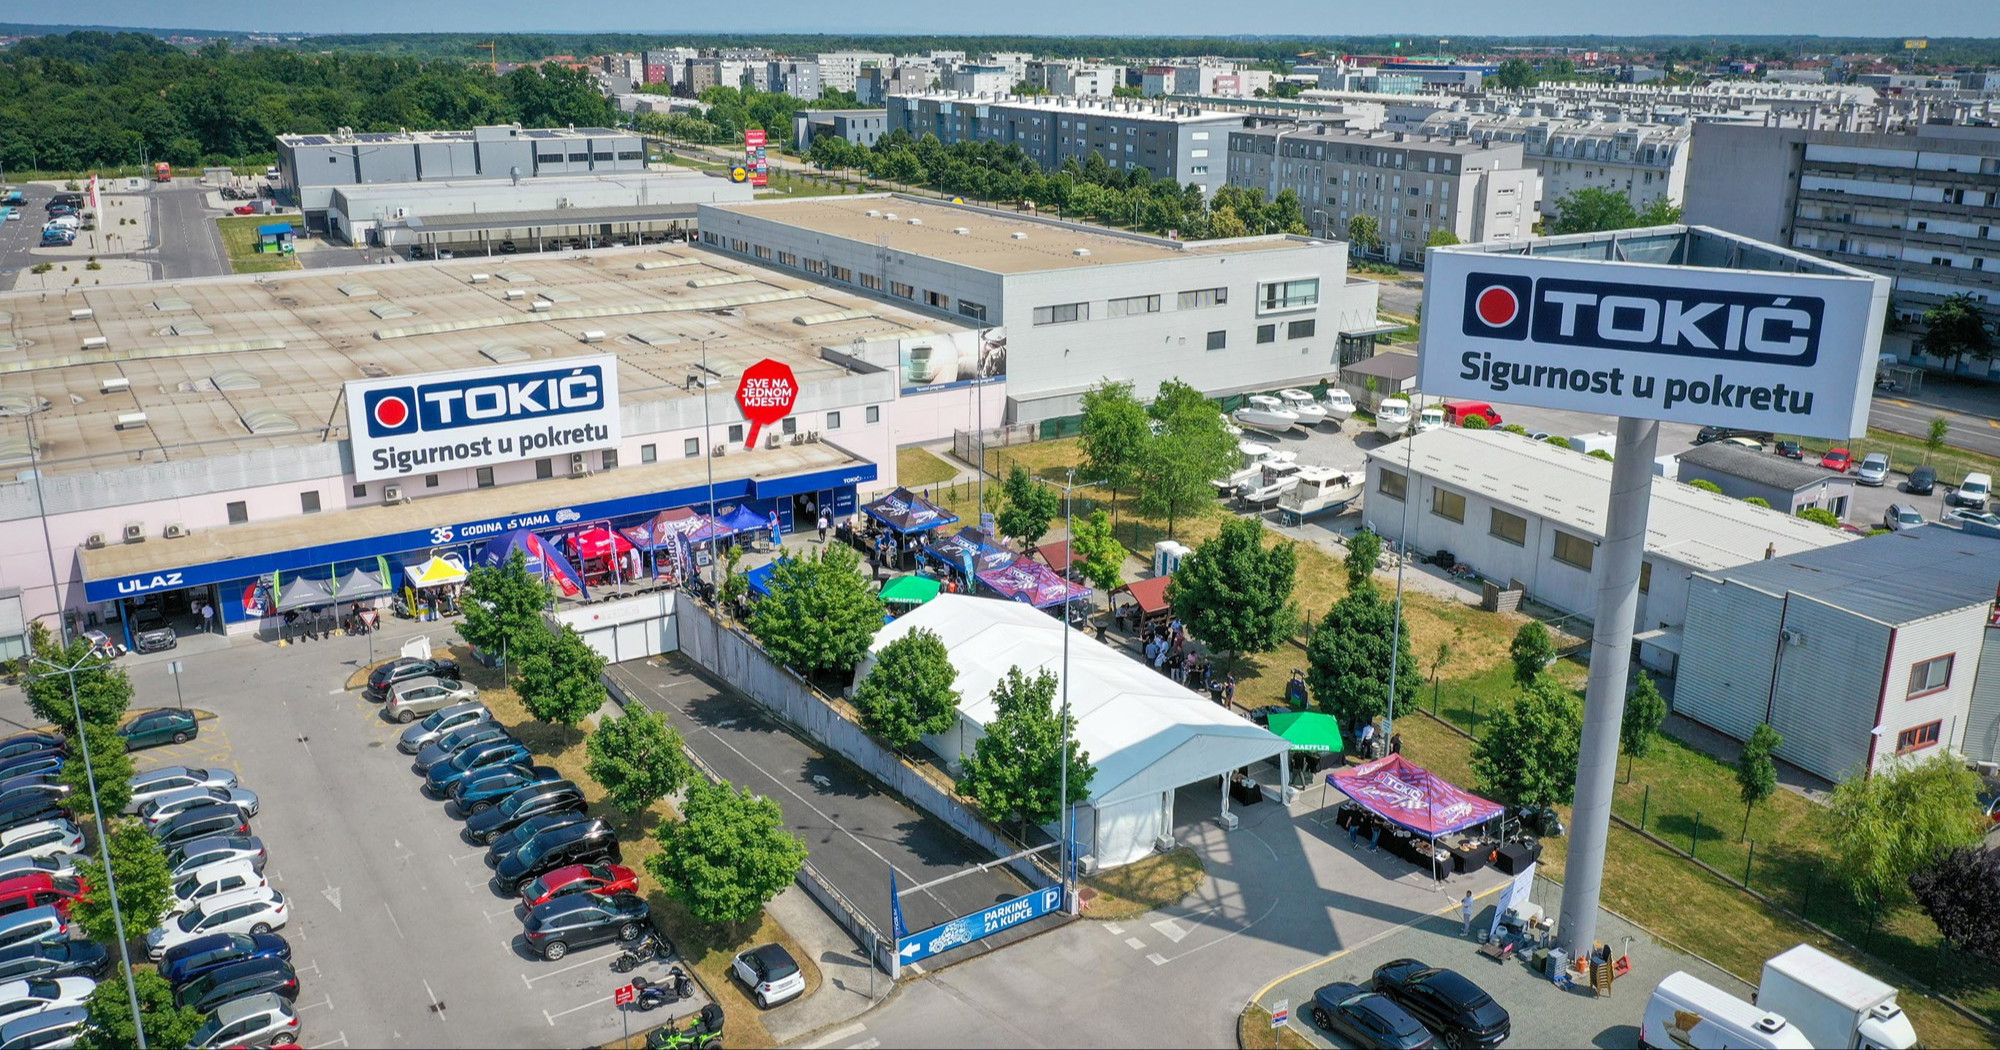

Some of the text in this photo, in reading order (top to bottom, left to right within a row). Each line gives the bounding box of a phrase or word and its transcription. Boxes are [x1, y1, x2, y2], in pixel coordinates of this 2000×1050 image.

[1544, 290, 1811, 356] TOKIĆ
[742, 388, 792, 398] JEDNOM
[746, 378, 789, 388] SVE NA
[1459, 350, 1814, 415] Sigurnost u pokretu
[424, 368, 599, 424] TOKIĆ
[744, 397, 789, 407] MJESTU
[372, 422, 609, 473] Sigurnost u pokretu
[430, 526, 455, 545] 35
[461, 521, 503, 537] GODINA
[519, 514, 550, 527] VAMA
[117, 572, 184, 594] ULAZ
[984, 898, 1029, 923] PARKING
[1045, 890, 1058, 909] P
[984, 906, 1033, 933] ZA KUPCE
